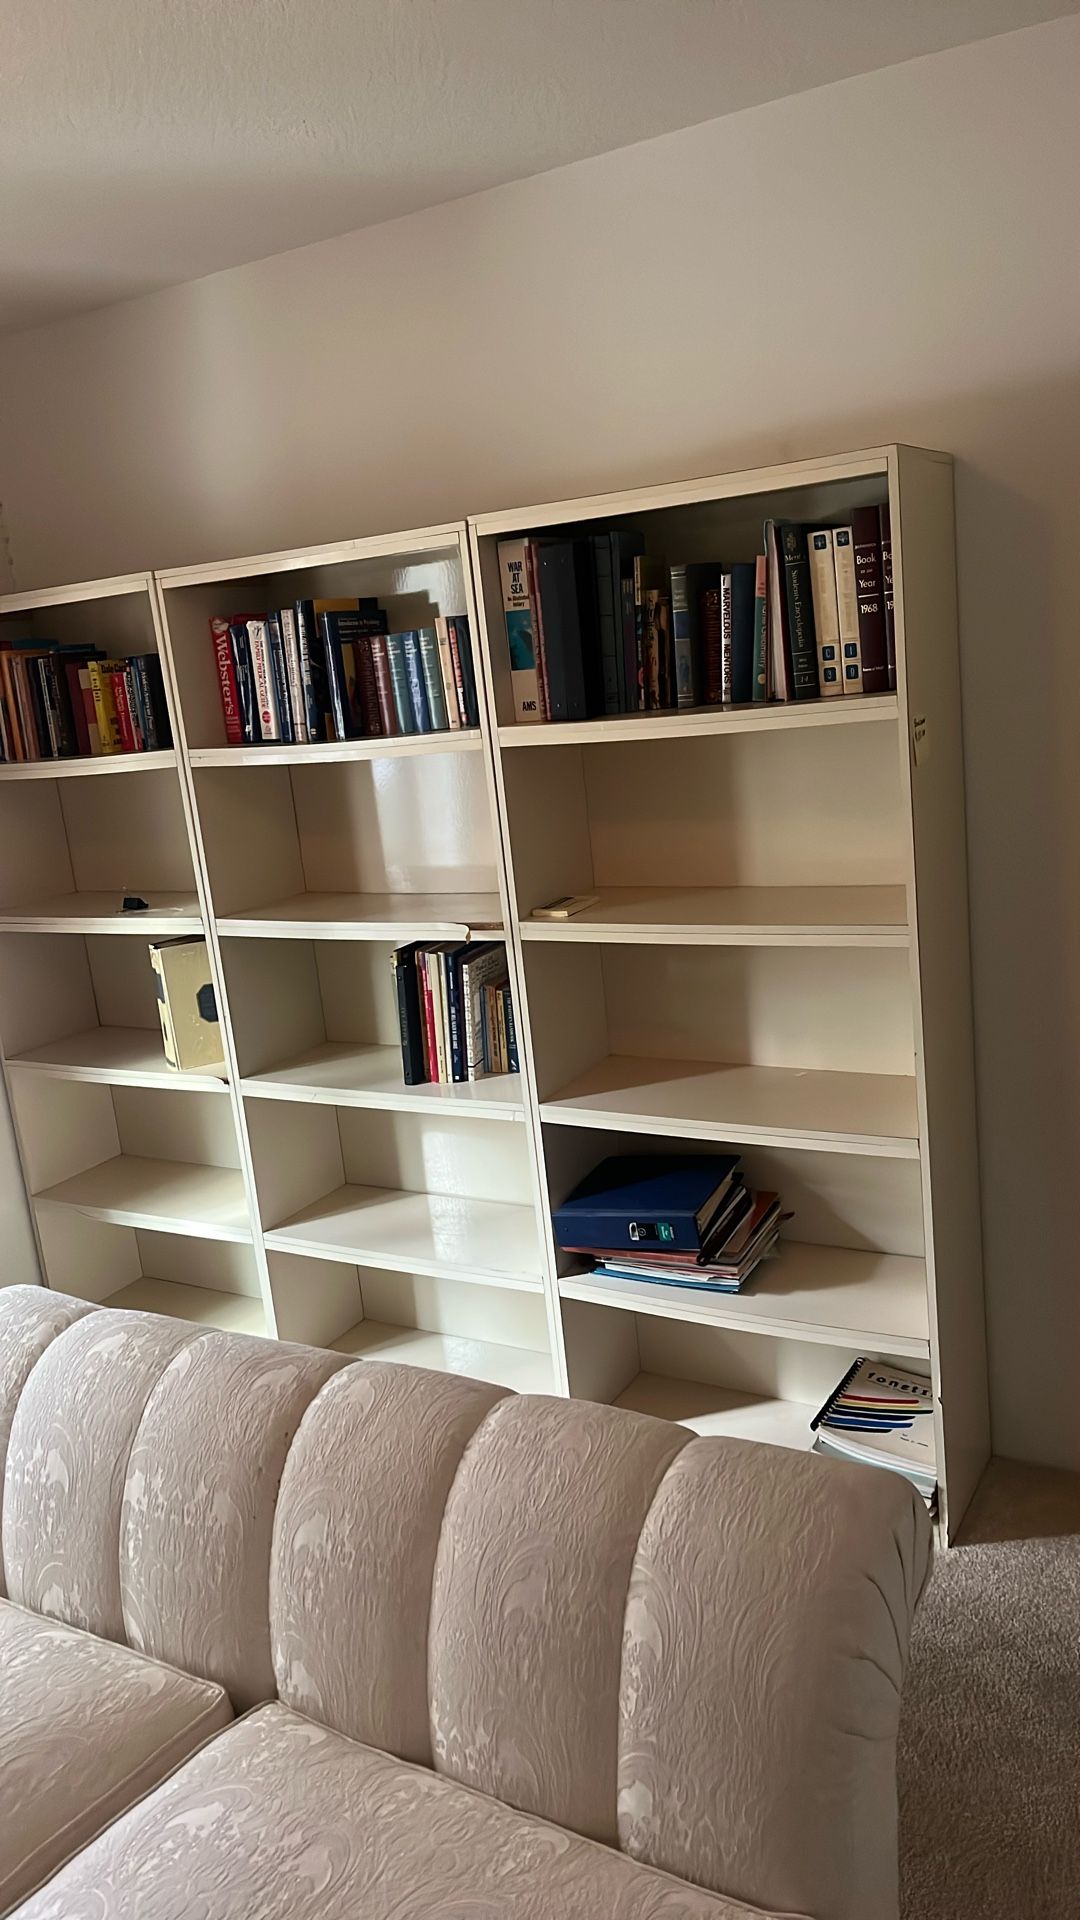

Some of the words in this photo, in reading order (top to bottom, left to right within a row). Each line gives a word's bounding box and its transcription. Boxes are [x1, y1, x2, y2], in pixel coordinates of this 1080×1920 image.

[856, 552, 876, 565] Book
[882, 551, 893, 561] Bo
[507, 560, 523, 572] WAR
[512, 572, 520, 583] AT
[884, 575, 893, 584] Ye
[510, 583, 524, 594] SEA
[859, 579, 876, 589] Year
[860, 603, 878, 614] 1968
[886, 601, 894, 610] 19
[722, 587, 731, 640] MARVELOUS
[723, 643, 732, 685] MENTORS
[215, 634, 234, 716] Webster's
[522, 700, 537, 712] AMS
